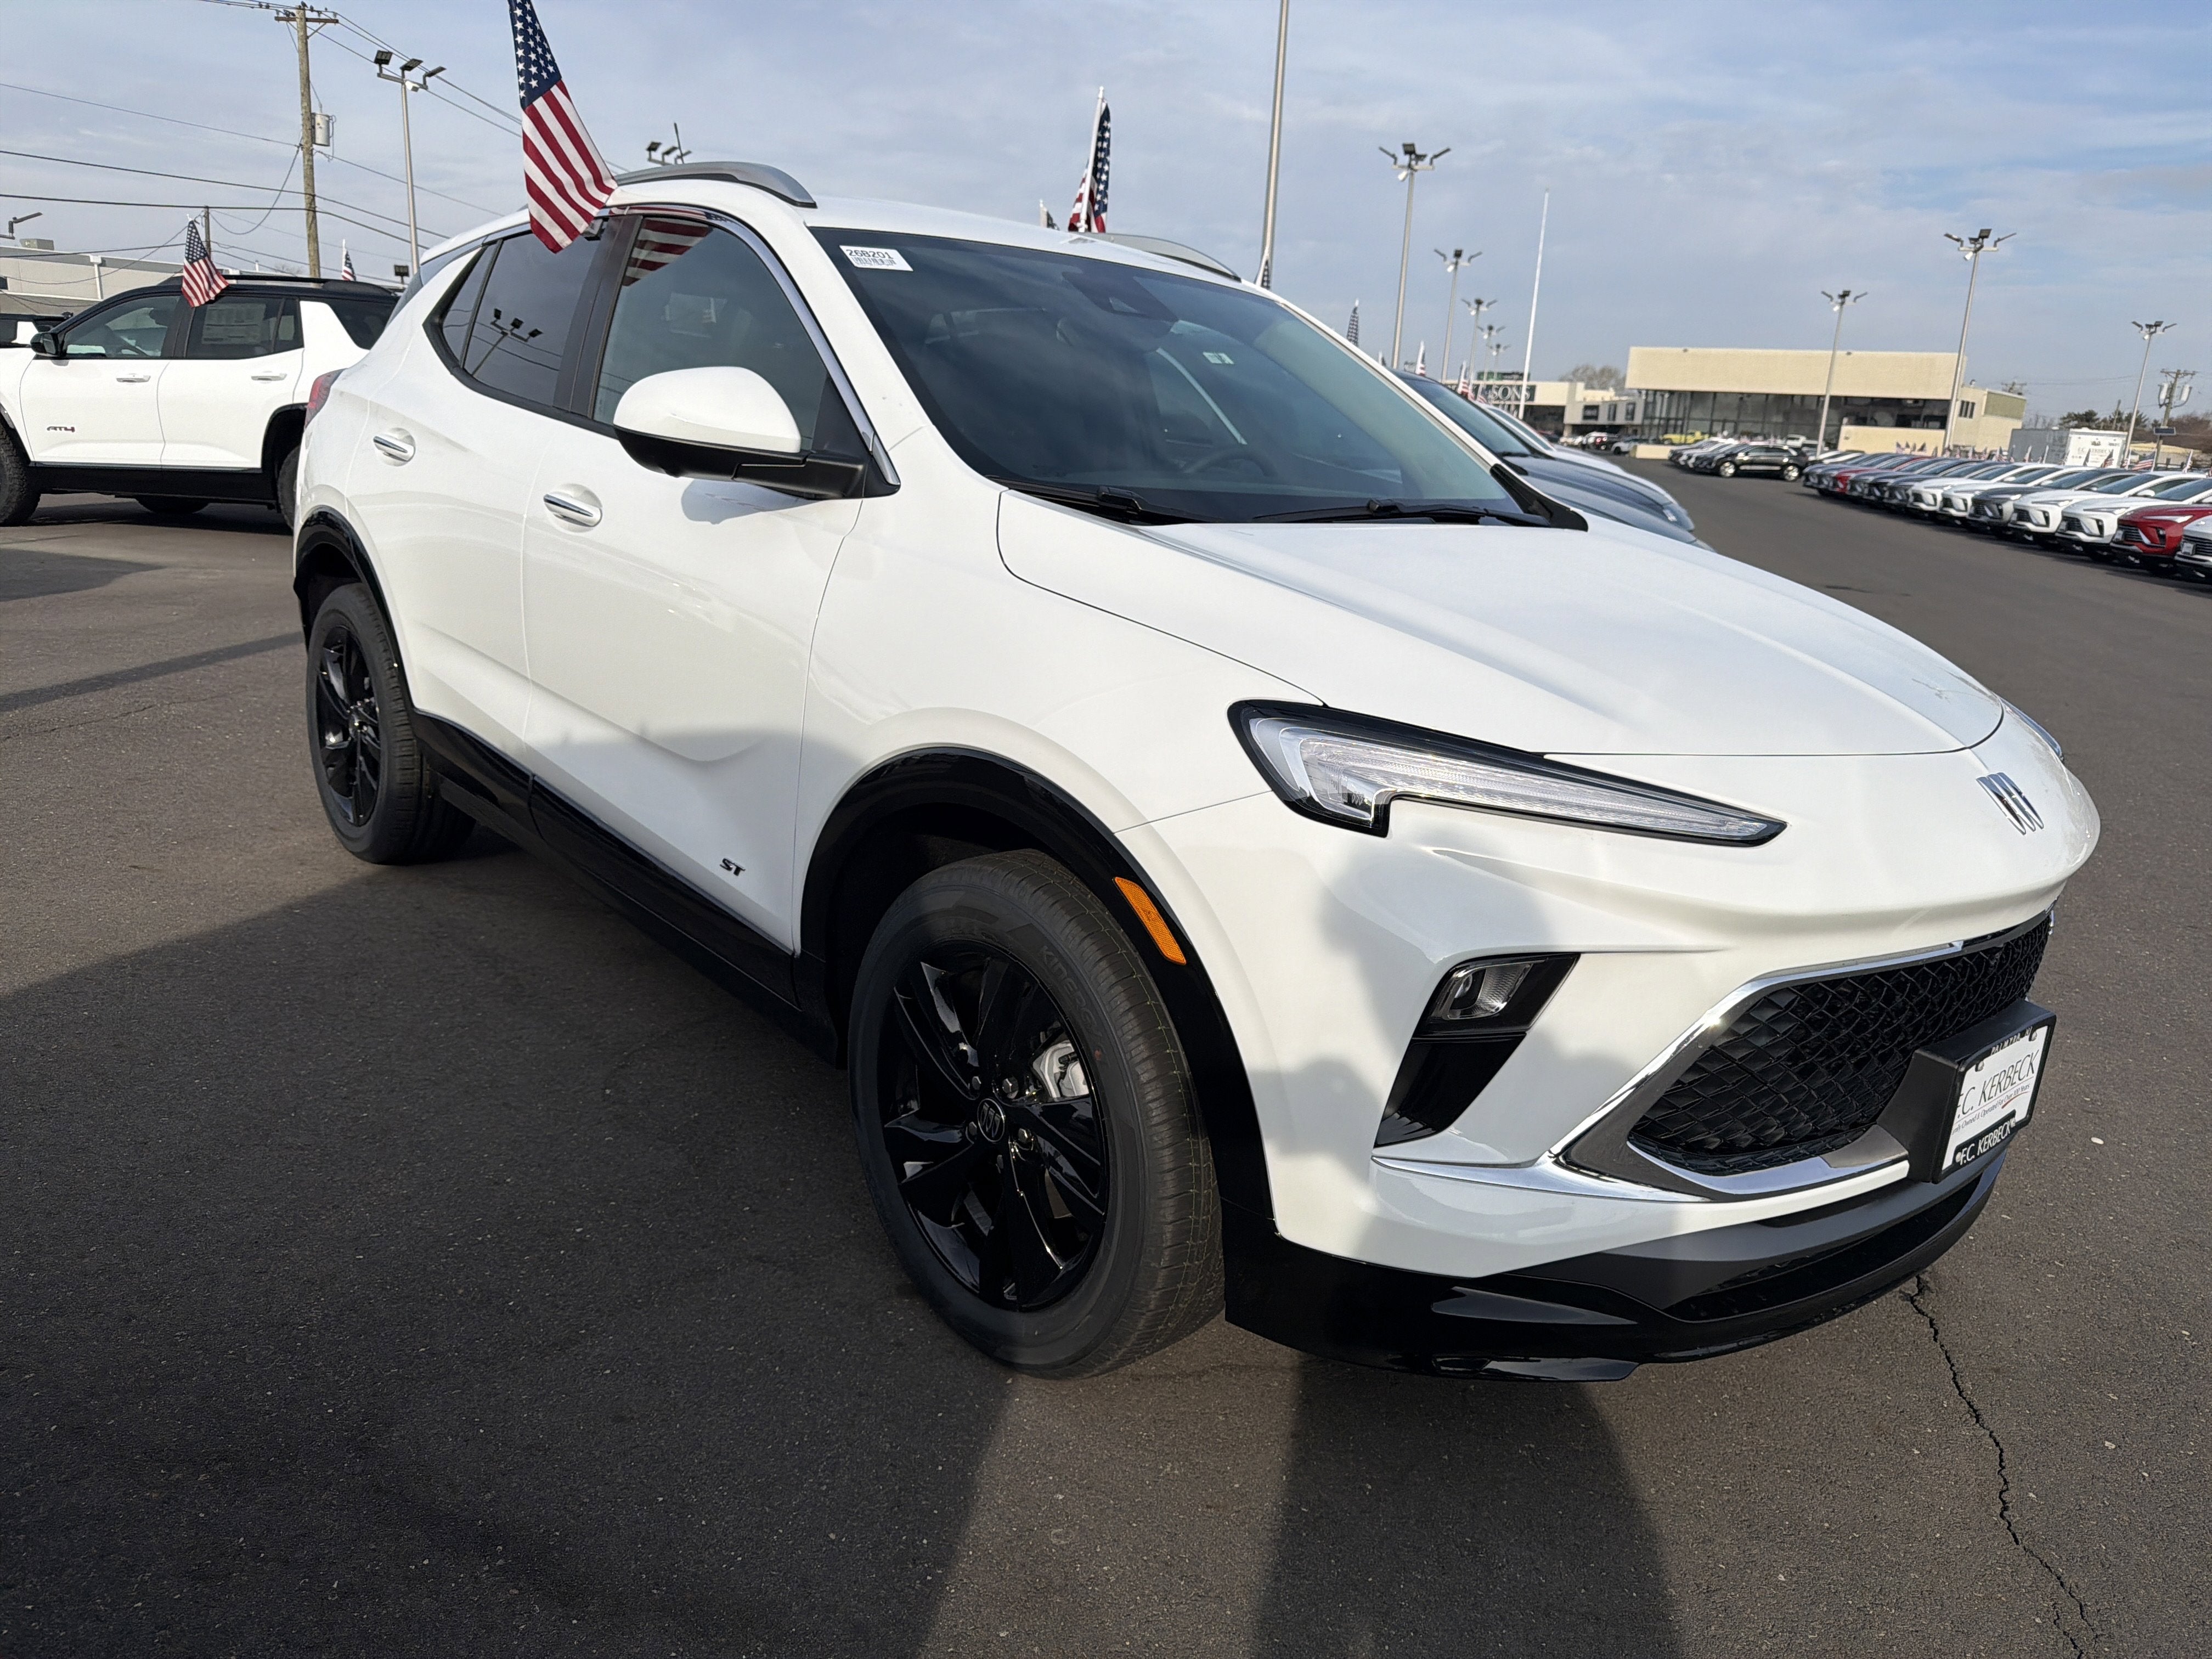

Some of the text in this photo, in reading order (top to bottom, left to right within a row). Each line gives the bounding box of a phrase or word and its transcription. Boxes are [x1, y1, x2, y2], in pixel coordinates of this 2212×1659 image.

[846, 249, 894, 259] 26B201
[719, 858, 746, 876] ST
[1978, 1049, 2040, 1107] KERBECK
[1960, 1119, 2012, 1166] F.C. KERBECK
